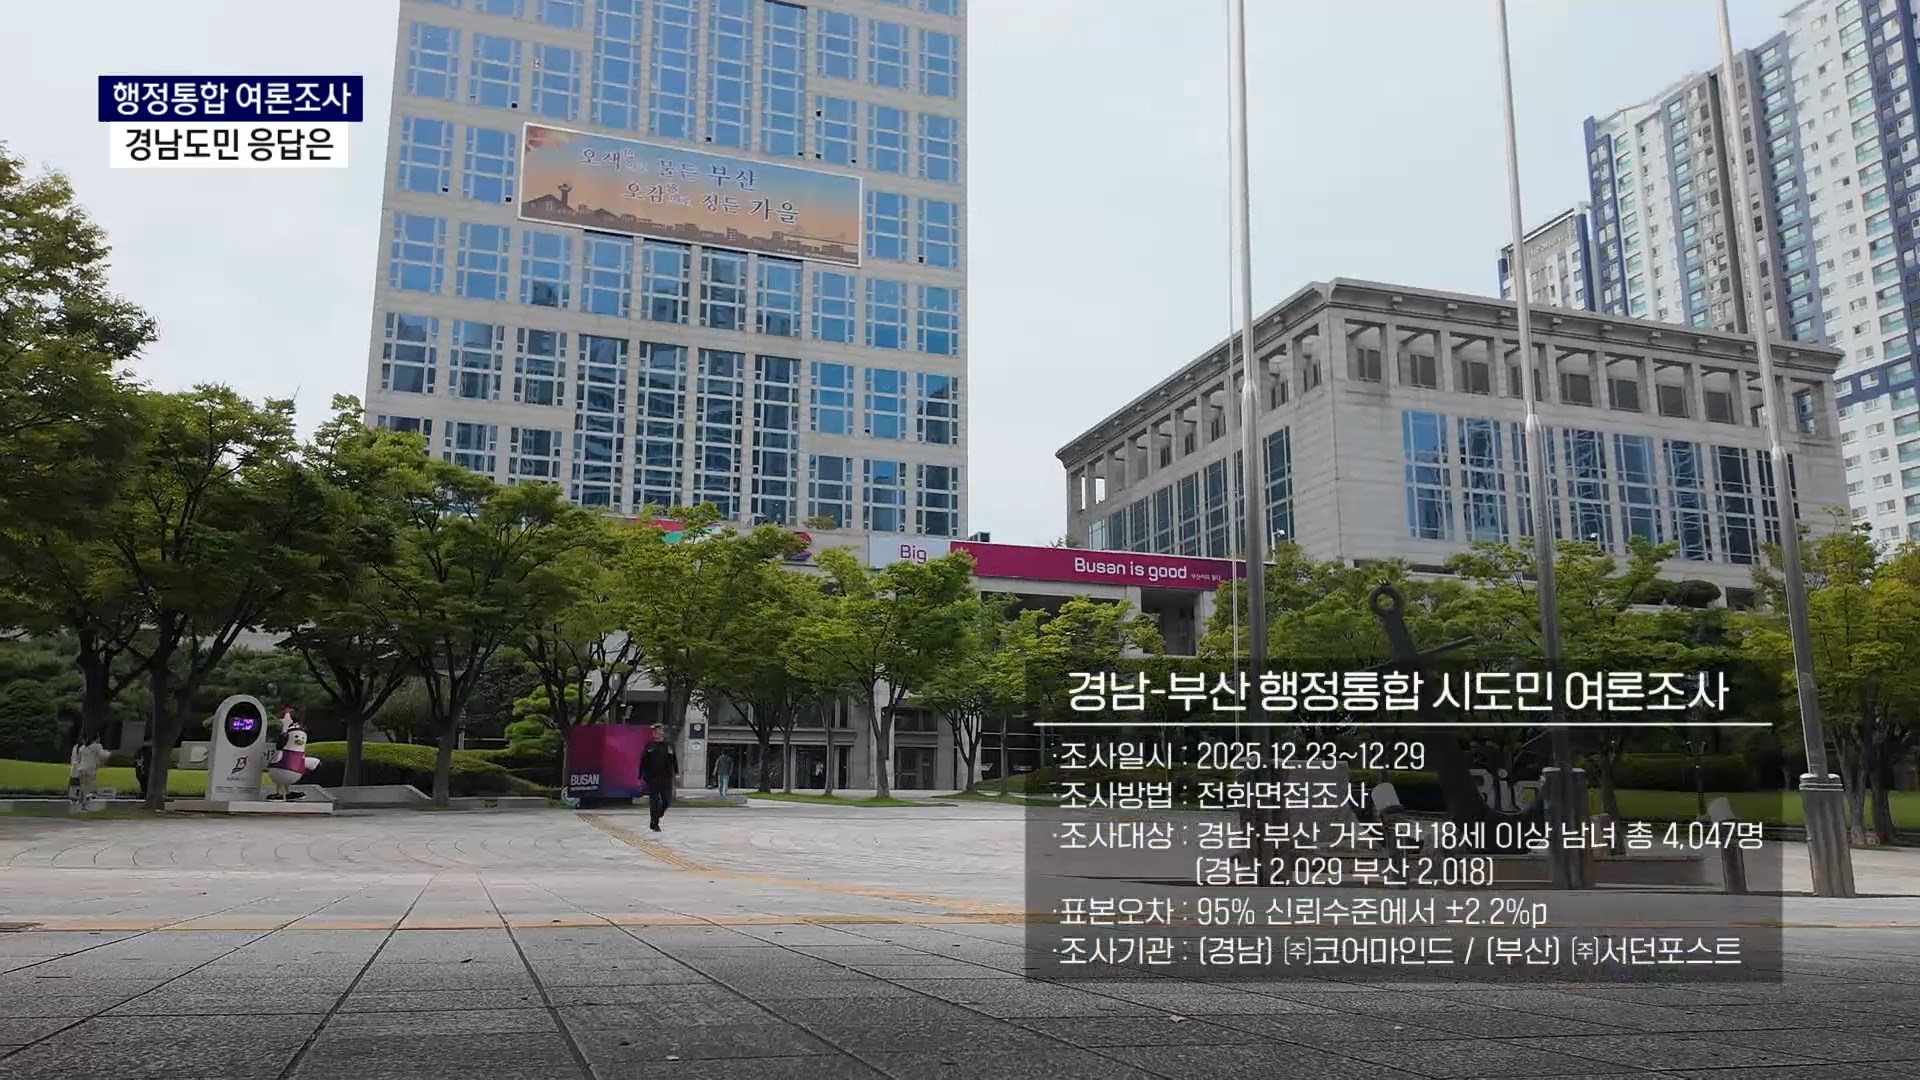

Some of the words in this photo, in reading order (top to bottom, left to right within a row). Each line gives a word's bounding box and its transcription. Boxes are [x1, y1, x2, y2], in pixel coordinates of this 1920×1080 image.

[708, 163, 757, 192] 부산
[750, 197, 800, 224] 가을
[900, 544, 928, 565] Big
[1074, 557, 1126, 576] Busan
[1129, 560, 1145, 576] is
[1148, 565, 1188, 582] good
[570, 773, 600, 786] BUSAN
